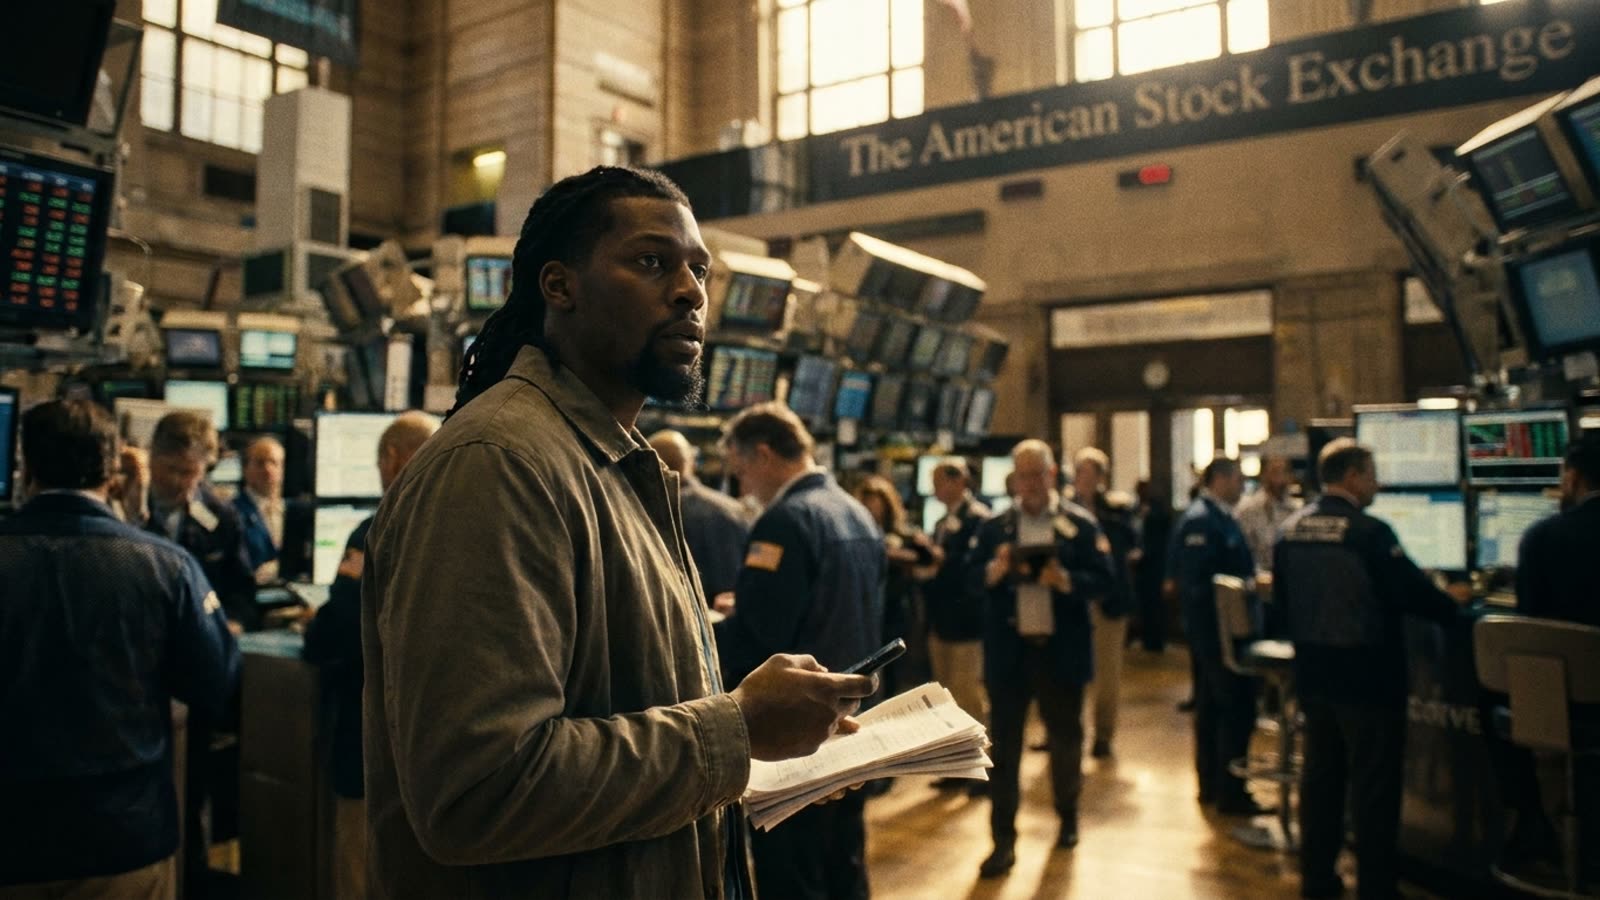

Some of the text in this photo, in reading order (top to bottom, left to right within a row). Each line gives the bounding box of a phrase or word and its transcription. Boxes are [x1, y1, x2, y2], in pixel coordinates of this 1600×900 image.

[840, 18, 1576, 177] The American Stock Exchange
